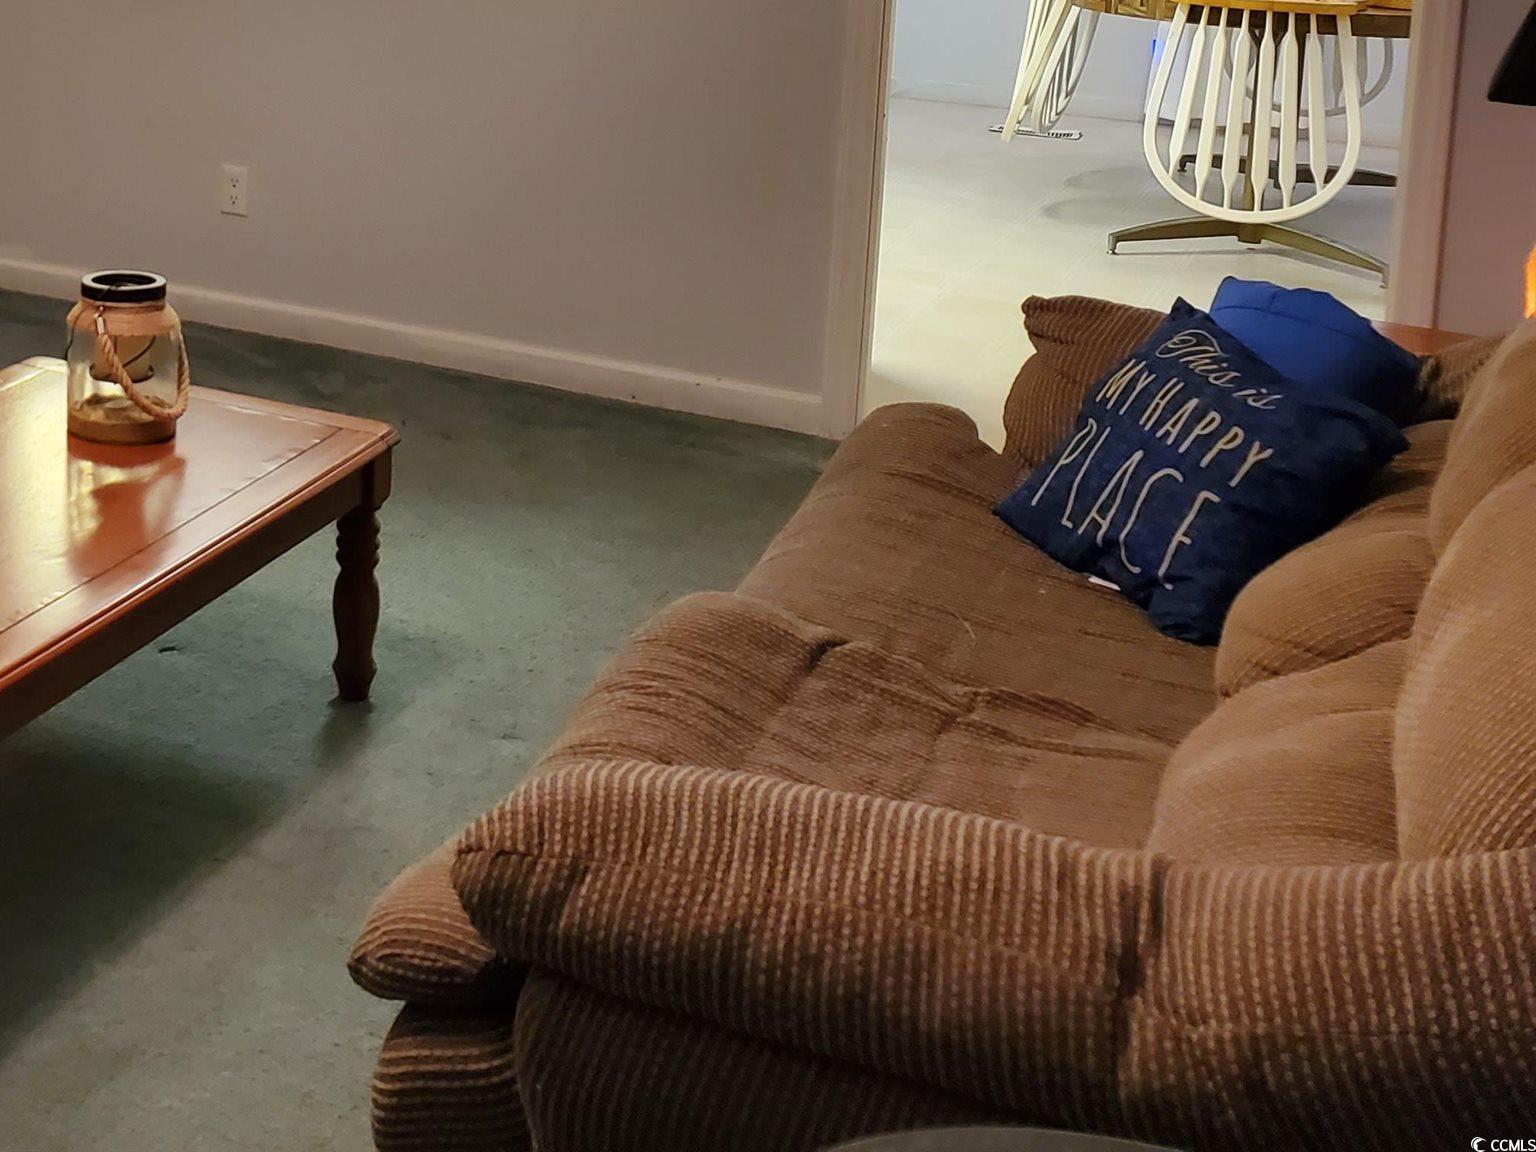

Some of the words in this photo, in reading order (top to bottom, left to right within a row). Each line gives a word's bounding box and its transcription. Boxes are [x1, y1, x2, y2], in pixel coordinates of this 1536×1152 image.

[1095, 358, 1158, 416] MY
[1140, 377, 1274, 488] HAPPY
[1155, 329, 1243, 389] This
[1233, 387, 1284, 410] is
[1031, 417, 1221, 590] PLACE
